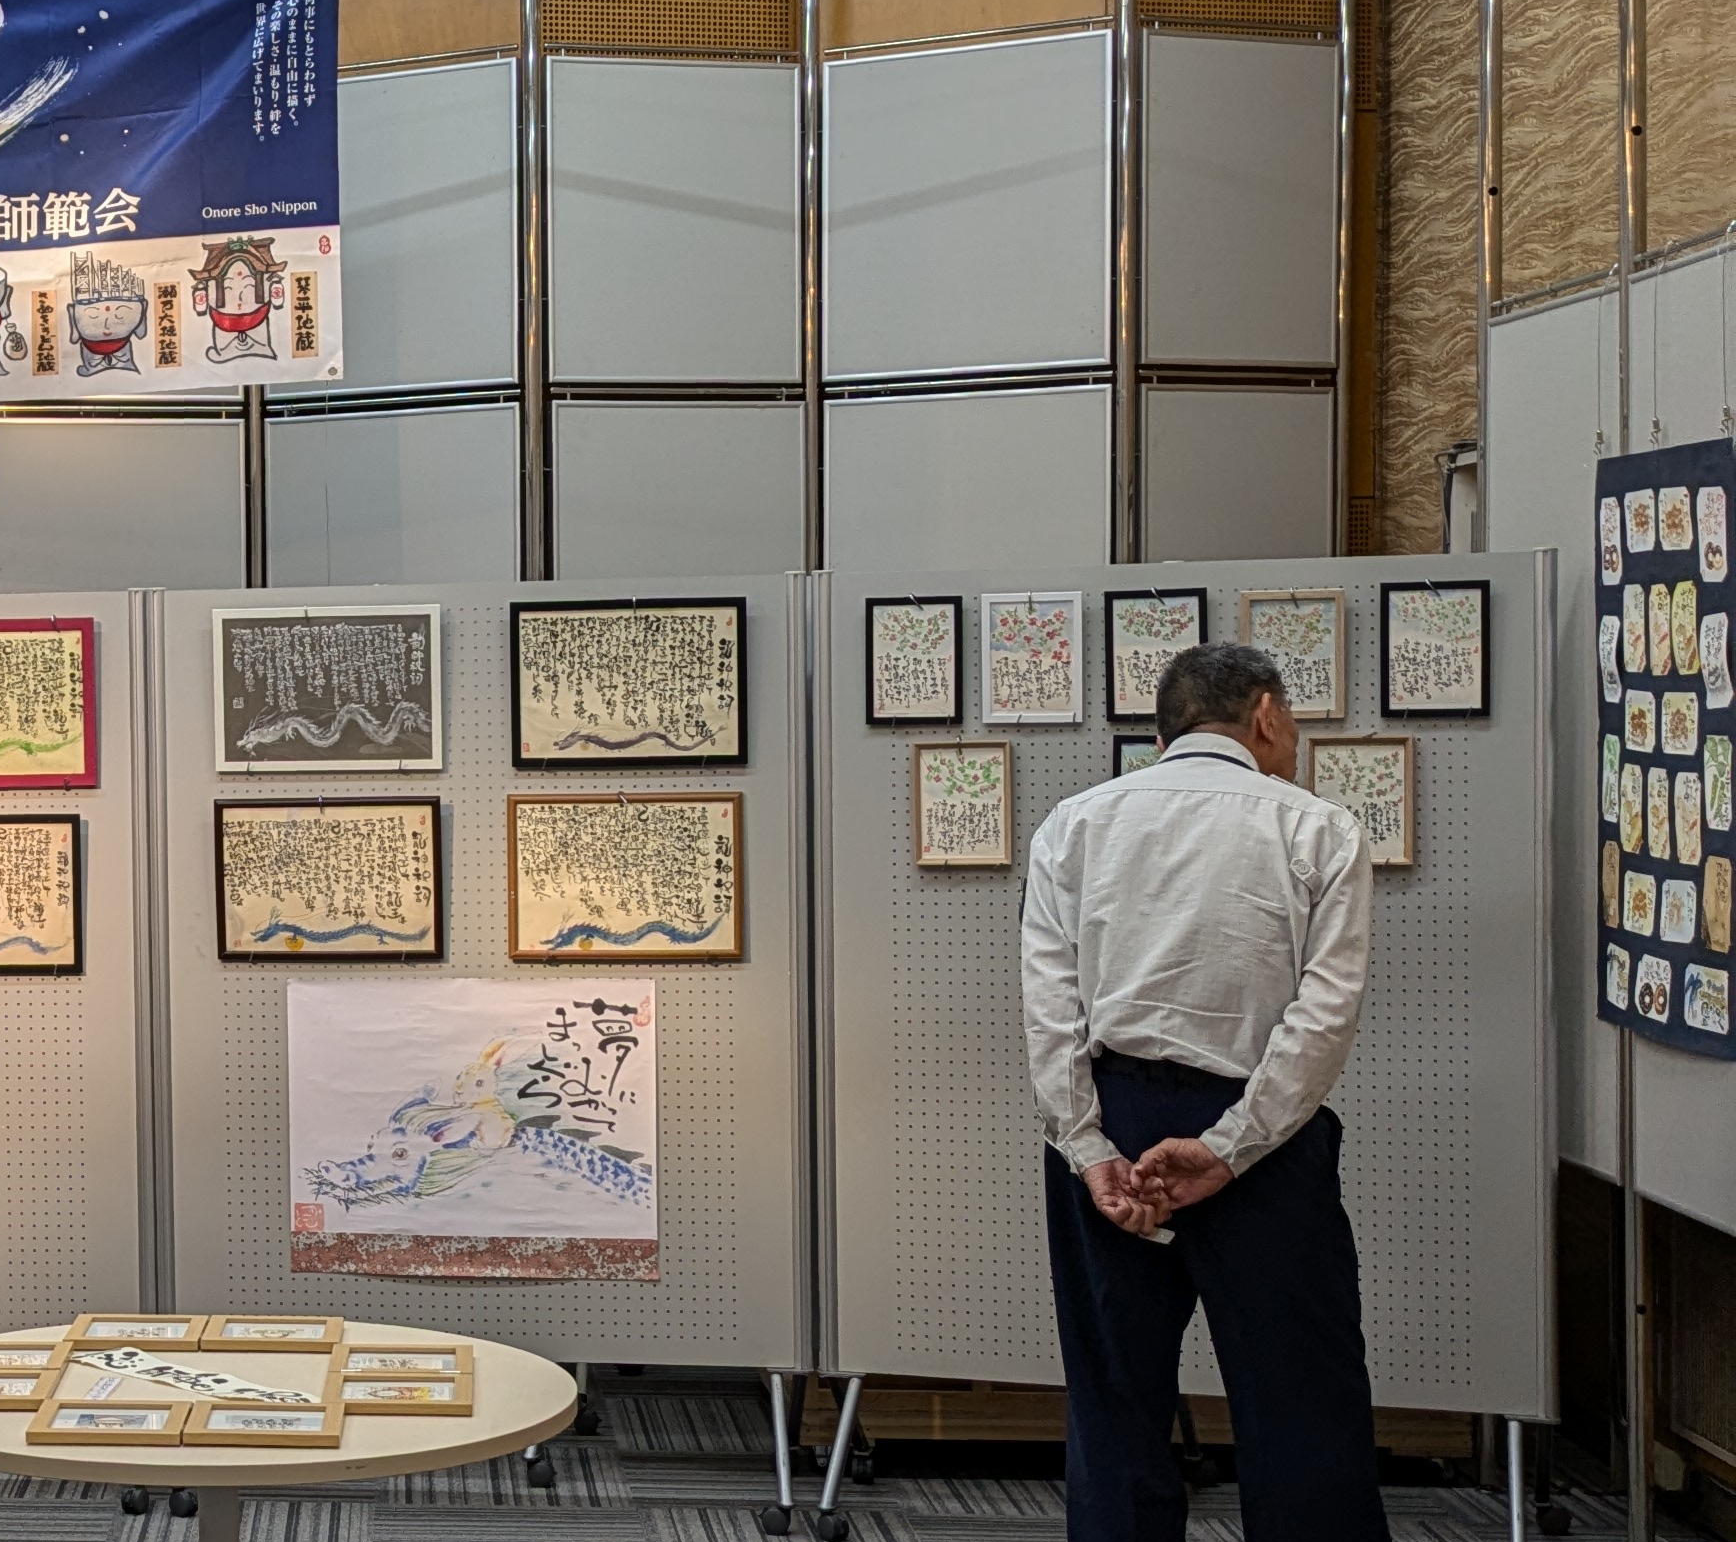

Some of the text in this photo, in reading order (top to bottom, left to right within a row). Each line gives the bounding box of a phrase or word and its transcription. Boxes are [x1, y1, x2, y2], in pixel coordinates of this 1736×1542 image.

[252, 2, 266, 142] 世界に広げてまいります。
[202, 200, 317, 219] Onore Sho Nippon
[573, 998, 638, 1104] 夢に
